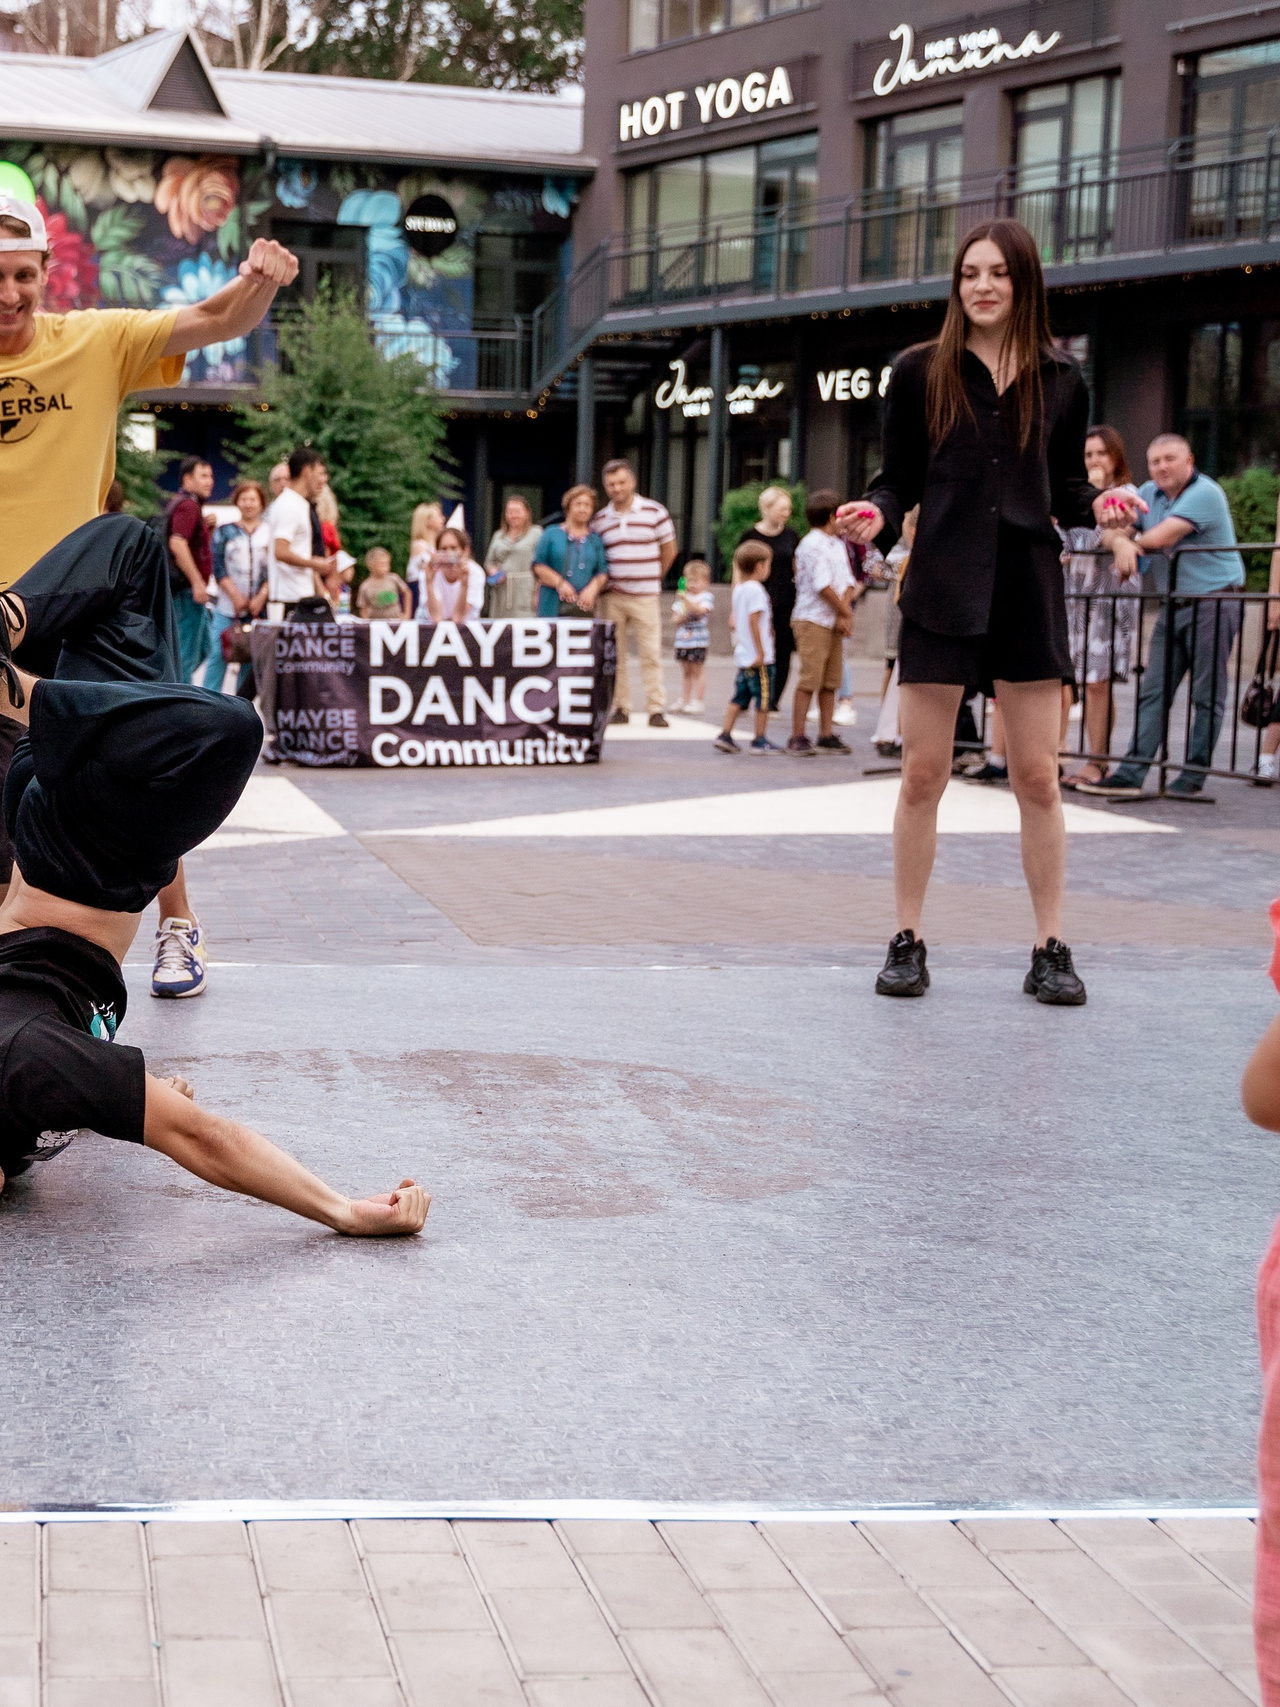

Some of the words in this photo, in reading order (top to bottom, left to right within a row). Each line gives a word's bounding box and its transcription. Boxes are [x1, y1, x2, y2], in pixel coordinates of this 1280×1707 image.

[620, 91, 687, 141] HOT
[695, 66, 794, 123] YOGA
[655, 359, 784, 409] Jamna
[816, 366, 871, 402] VEG
[274, 638, 356, 659] DANCE
[369, 620, 595, 668] MAYBE
[276, 708, 358, 730] MAYBE
[369, 675, 594, 726] DANCE
[279, 730, 359, 751] DANCE
[371, 731, 590, 768] Community
